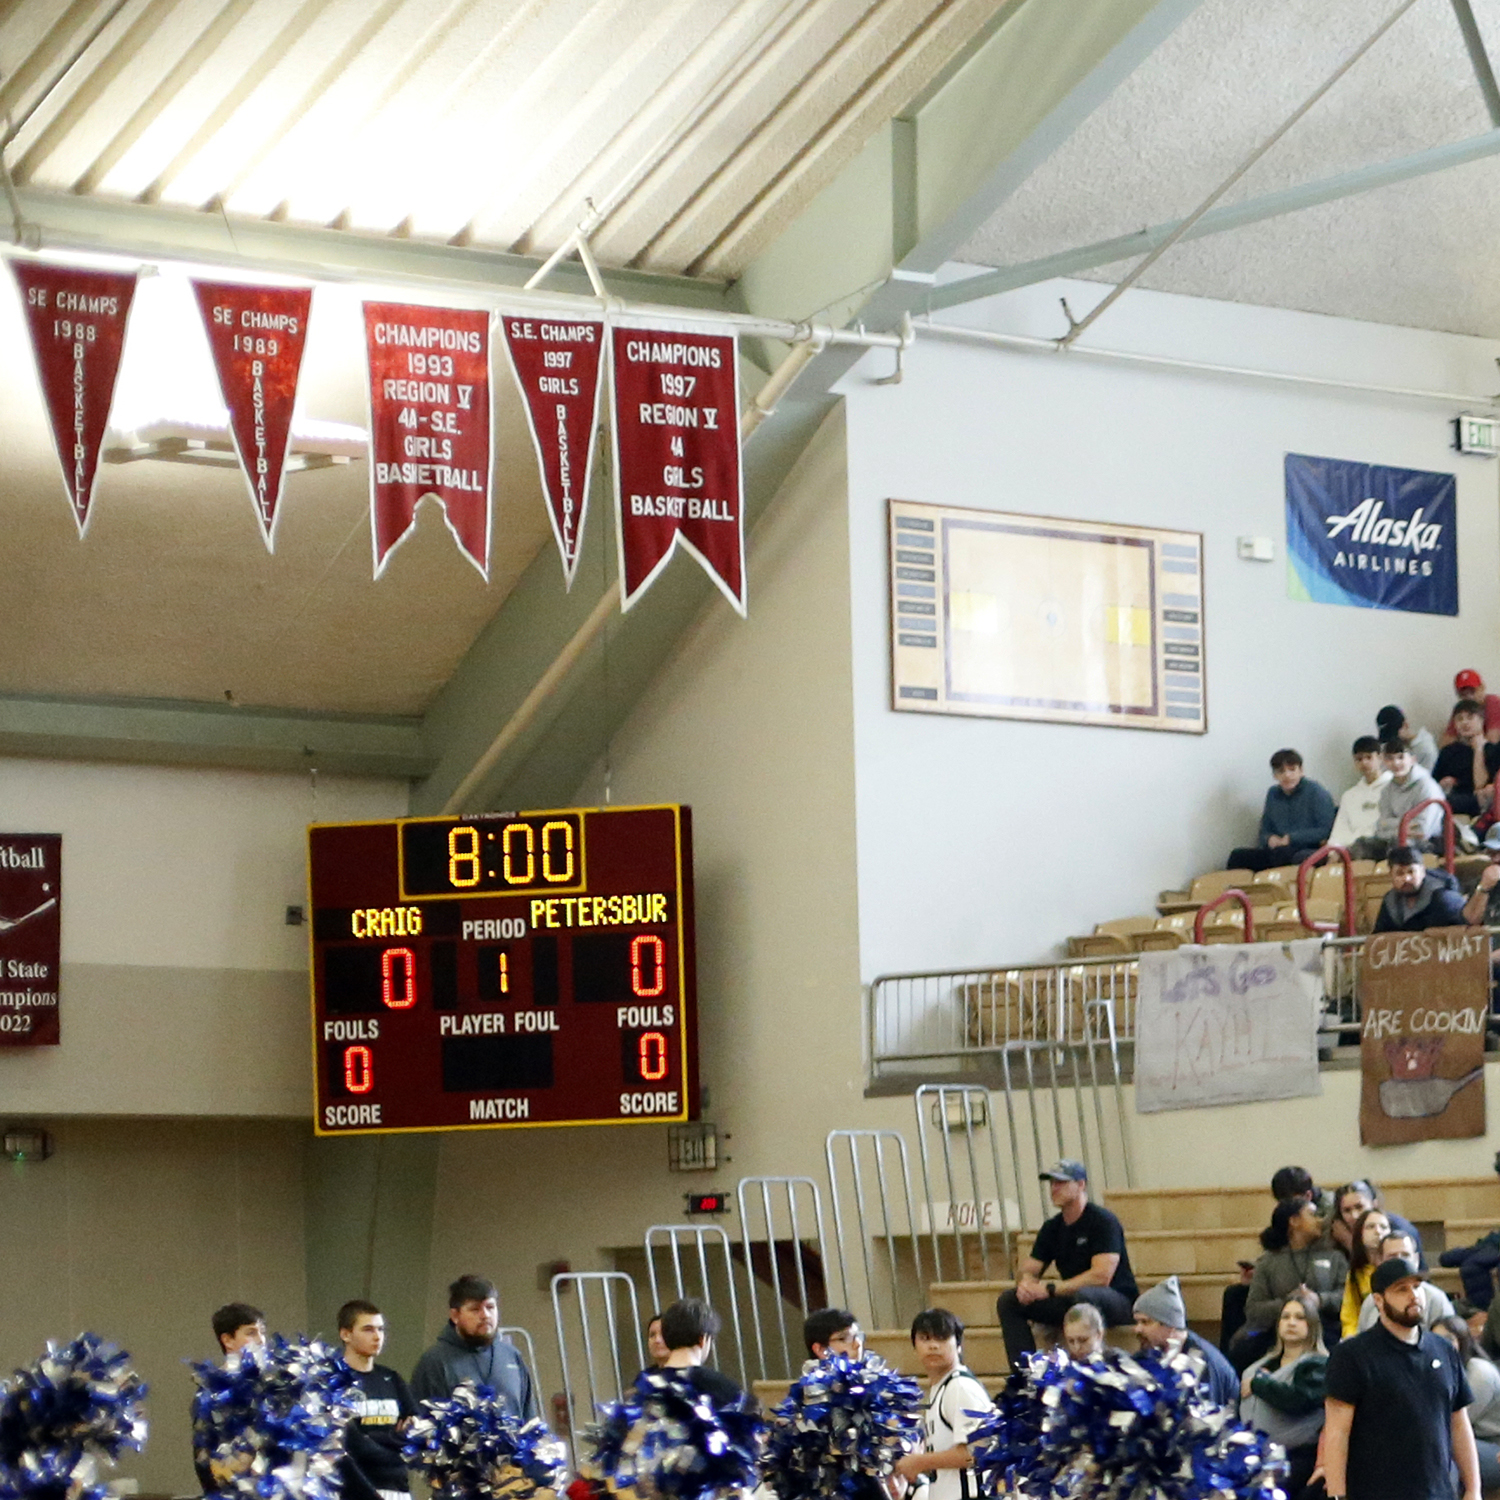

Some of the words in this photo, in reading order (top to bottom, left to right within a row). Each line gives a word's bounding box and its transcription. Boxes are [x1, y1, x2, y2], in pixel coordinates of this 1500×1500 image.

[28, 287, 47, 307] SE
[56, 292, 118, 315] CHAMPS
[54, 320, 96, 341] 1988
[213, 306, 232, 325] SE
[241, 310, 298, 334] CHAMPS
[511, 322, 537, 339] S.E.
[541, 324, 595, 342] CHAMPS
[233, 334, 277, 357] 1989
[374, 323, 481, 352] CHAMPIONS
[408, 353, 453, 376] 1993
[543, 352, 572, 368] 1997
[627, 341, 721, 369] CHAMPIONS
[383, 379, 449, 404] REGION
[539, 376, 579, 395] GIRLS
[660, 374, 696, 398] 1997
[74, 343, 85, 509] BASKETBALL
[639, 403, 698, 427] REGION
[251, 360, 272, 522] BASKETBALL
[404, 435, 452, 460] GIRLS
[556, 404, 575, 559] BASKETBALL
[630, 495, 735, 521] BASKETBALL
[1326, 498, 1442, 555] Alaska
[1334, 550, 1432, 577] AIRLINES
[0, 847, 45, 868] tball
[448, 821, 574, 888] 8:00
[351, 906, 422, 938] CRAIG
[531, 893, 667, 929] PETERSBUR
[462, 918, 526, 940] PERIOD
[1368, 935, 1432, 969] GUESS
[1438, 935, 1485, 963] WHAT
[8, 958, 48, 978] State
[381, 947, 416, 1009] 0
[498, 952, 509, 994] 1
[630, 934, 665, 997] 0
[0, 988, 57, 1010] mpions
[0, 1014, 31, 1032] 022
[440, 1014, 505, 1035] PLAYER
[514, 1011, 560, 1032] FOUL
[617, 1005, 674, 1028] FOULS
[1364, 1009, 1402, 1038] ARE
[324, 1019, 379, 1041] FOULS
[638, 1032, 667, 1080] 0
[344, 1045, 372, 1094] 0
[325, 1104, 382, 1126] SCORE
[469, 1099, 529, 1120] MATCH
[620, 1091, 678, 1114] SCORE
